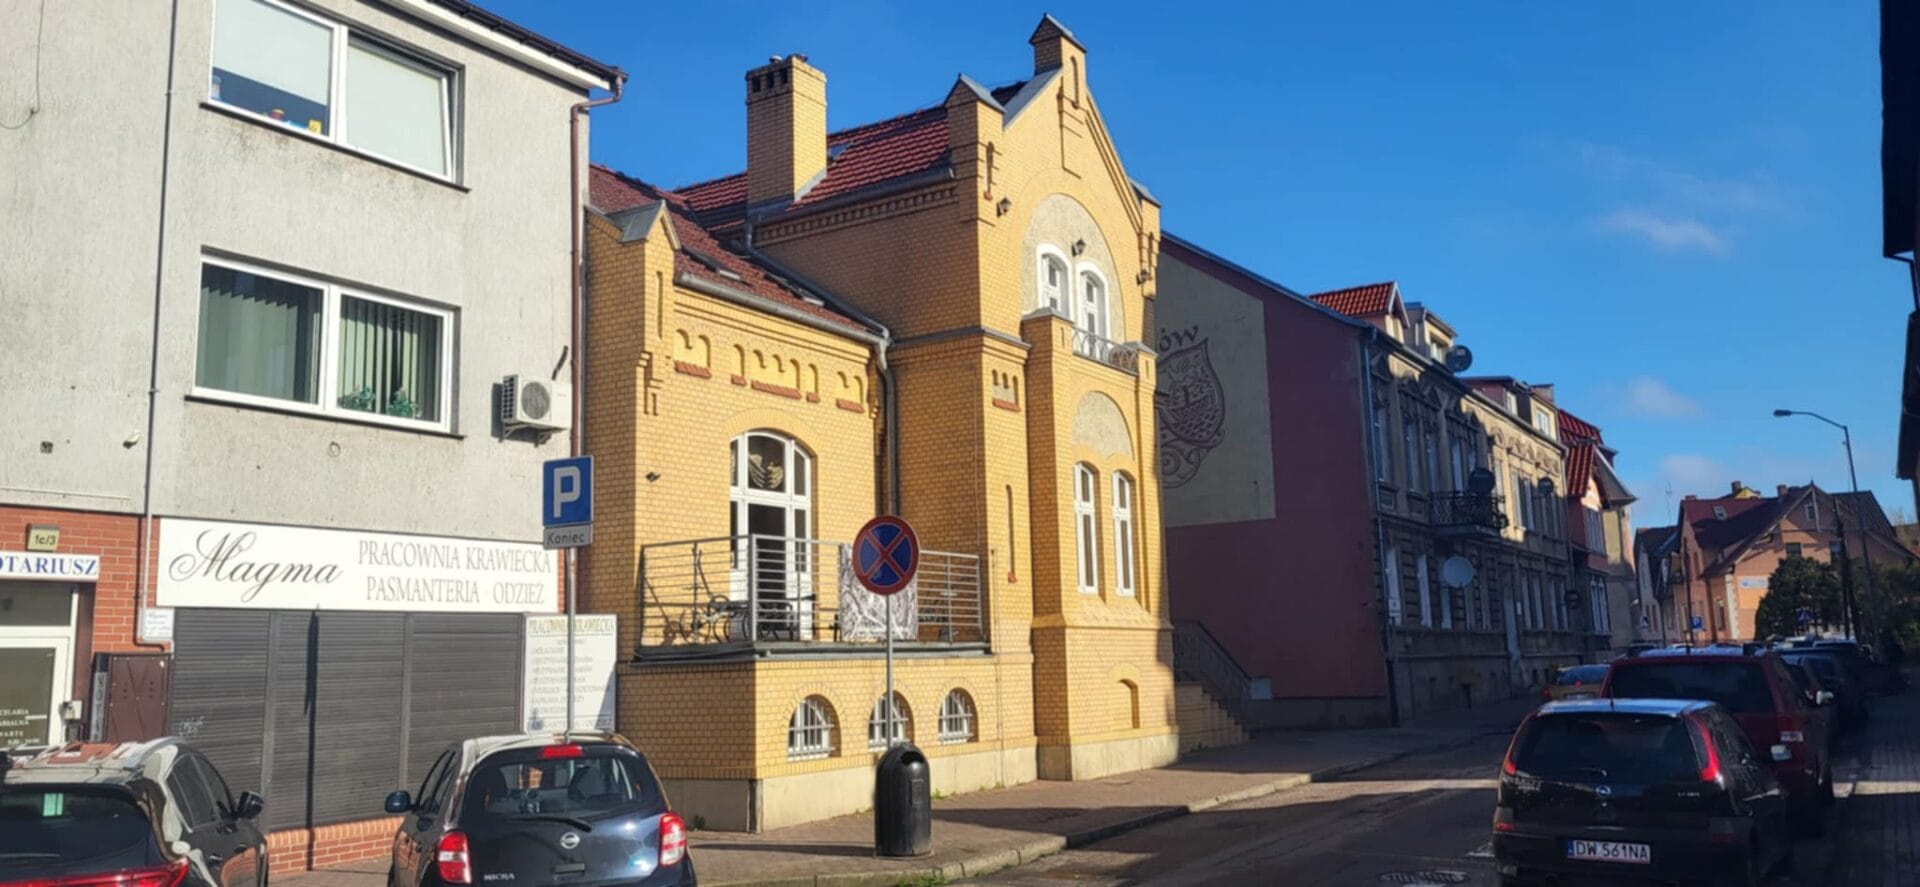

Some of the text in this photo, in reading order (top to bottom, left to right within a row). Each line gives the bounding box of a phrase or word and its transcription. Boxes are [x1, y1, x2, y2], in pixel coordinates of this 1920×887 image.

[553, 465, 581, 519] P
[35, 534, 57, 546] 1c/3
[547, 531, 585, 545] Koniec
[0, 555, 98, 576] TARIUSZ
[169, 529, 343, 603] Magma
[358, 539, 552, 574] PRACOWNIA KRAWIECKA
[366, 576, 480, 604] PASMANTERIA
[493, 581, 545, 605] ODZIEŻ
[1575, 841, 1649, 859] DW 561NA
